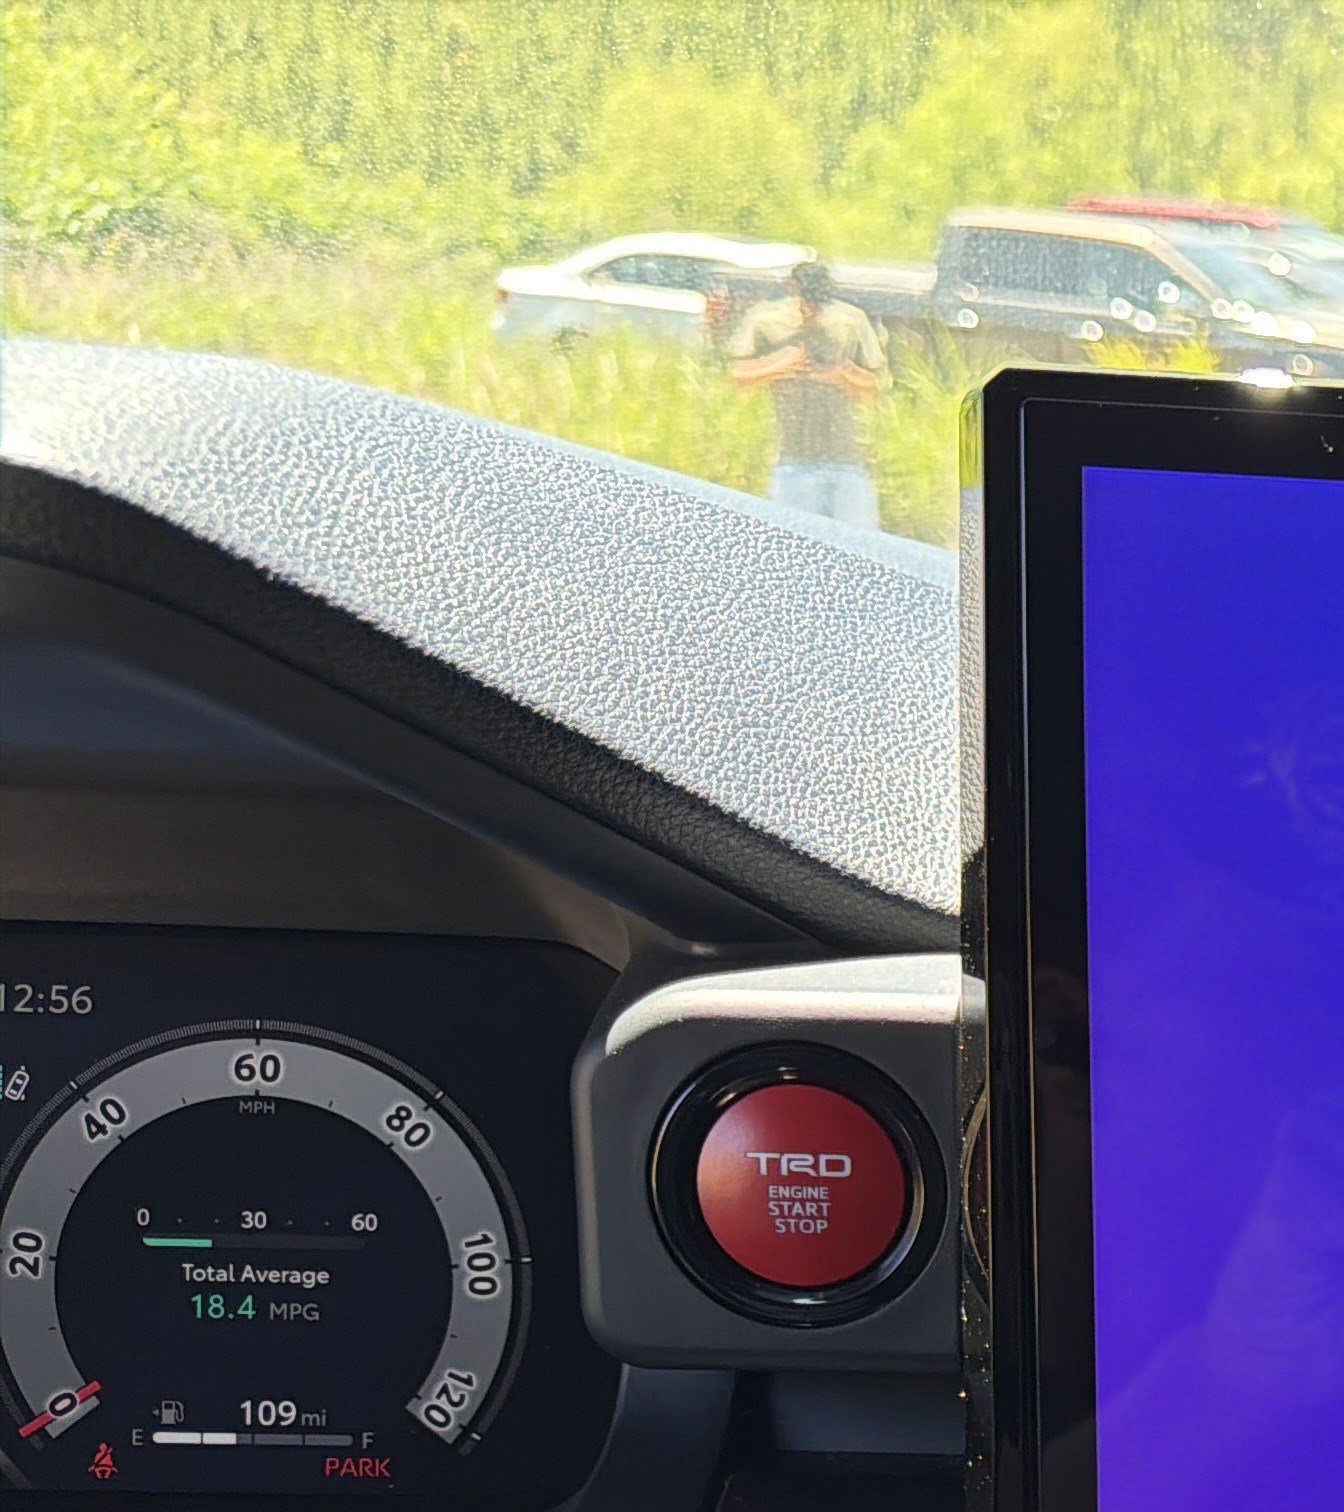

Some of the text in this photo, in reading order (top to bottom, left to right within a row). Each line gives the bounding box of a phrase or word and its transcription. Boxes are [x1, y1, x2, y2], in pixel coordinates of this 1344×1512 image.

[0, 983, 93, 1015] 12:56
[234, 1052, 281, 1083] 60
[84, 1096, 127, 1142] 40
[238, 1100, 276, 1115] MPH
[385, 1104, 433, 1149] 80
[746, 1151, 852, 1178] TRD
[768, 1185, 829, 1200] ENGINE
[137, 1208, 379, 1233] 0 30 60
[768, 1201, 831, 1217] START
[775, 1219, 829, 1234] STOP
[9, 1231, 43, 1278] 20
[463, 1231, 499, 1297] 100
[182, 1263, 330, 1288] Total Average
[191, 1295, 320, 1322] 18.4 MPG
[240, 1401, 327, 1426] 109 mi
[423, 1370, 476, 1431] 120
[132, 1429, 374, 1449] E F
[325, 1458, 391, 1478] PARK
